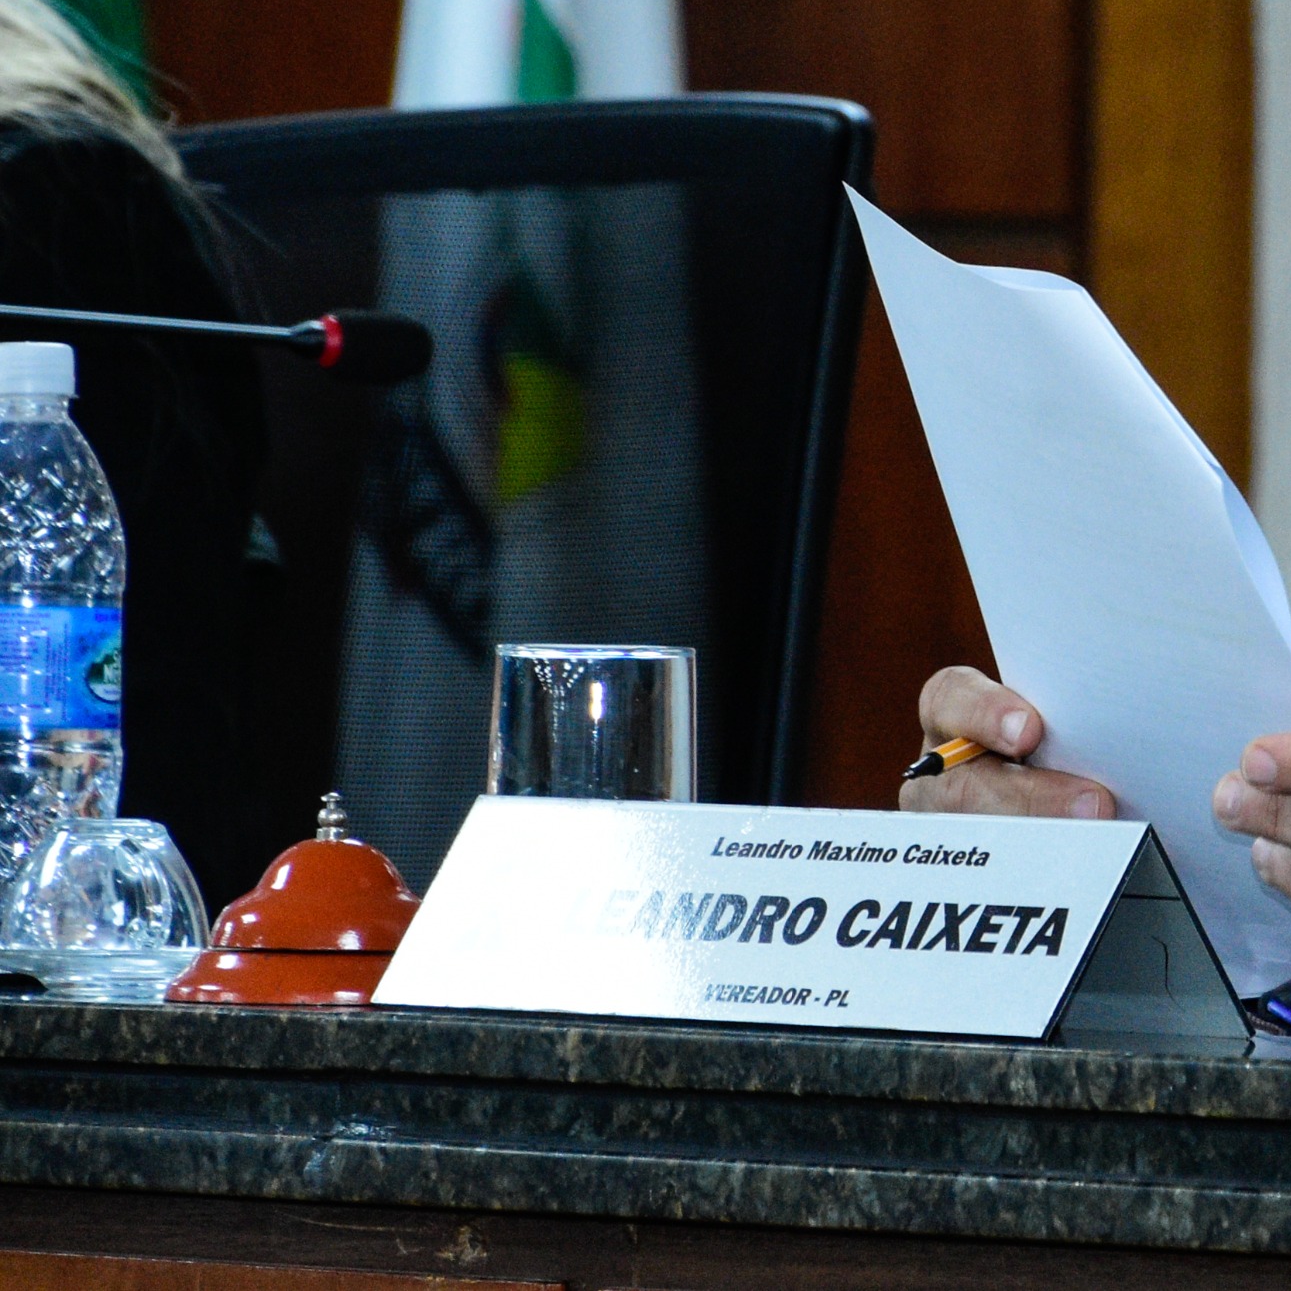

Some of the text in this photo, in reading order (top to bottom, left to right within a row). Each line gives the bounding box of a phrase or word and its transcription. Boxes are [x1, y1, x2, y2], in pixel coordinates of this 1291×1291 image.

[710, 837, 990, 867] Leandro Maximo Caixeta
[836, 899, 1069, 956] CAIXETA
[704, 983, 812, 1006] VEREADOR
[824, 990, 850, 1008] PL
